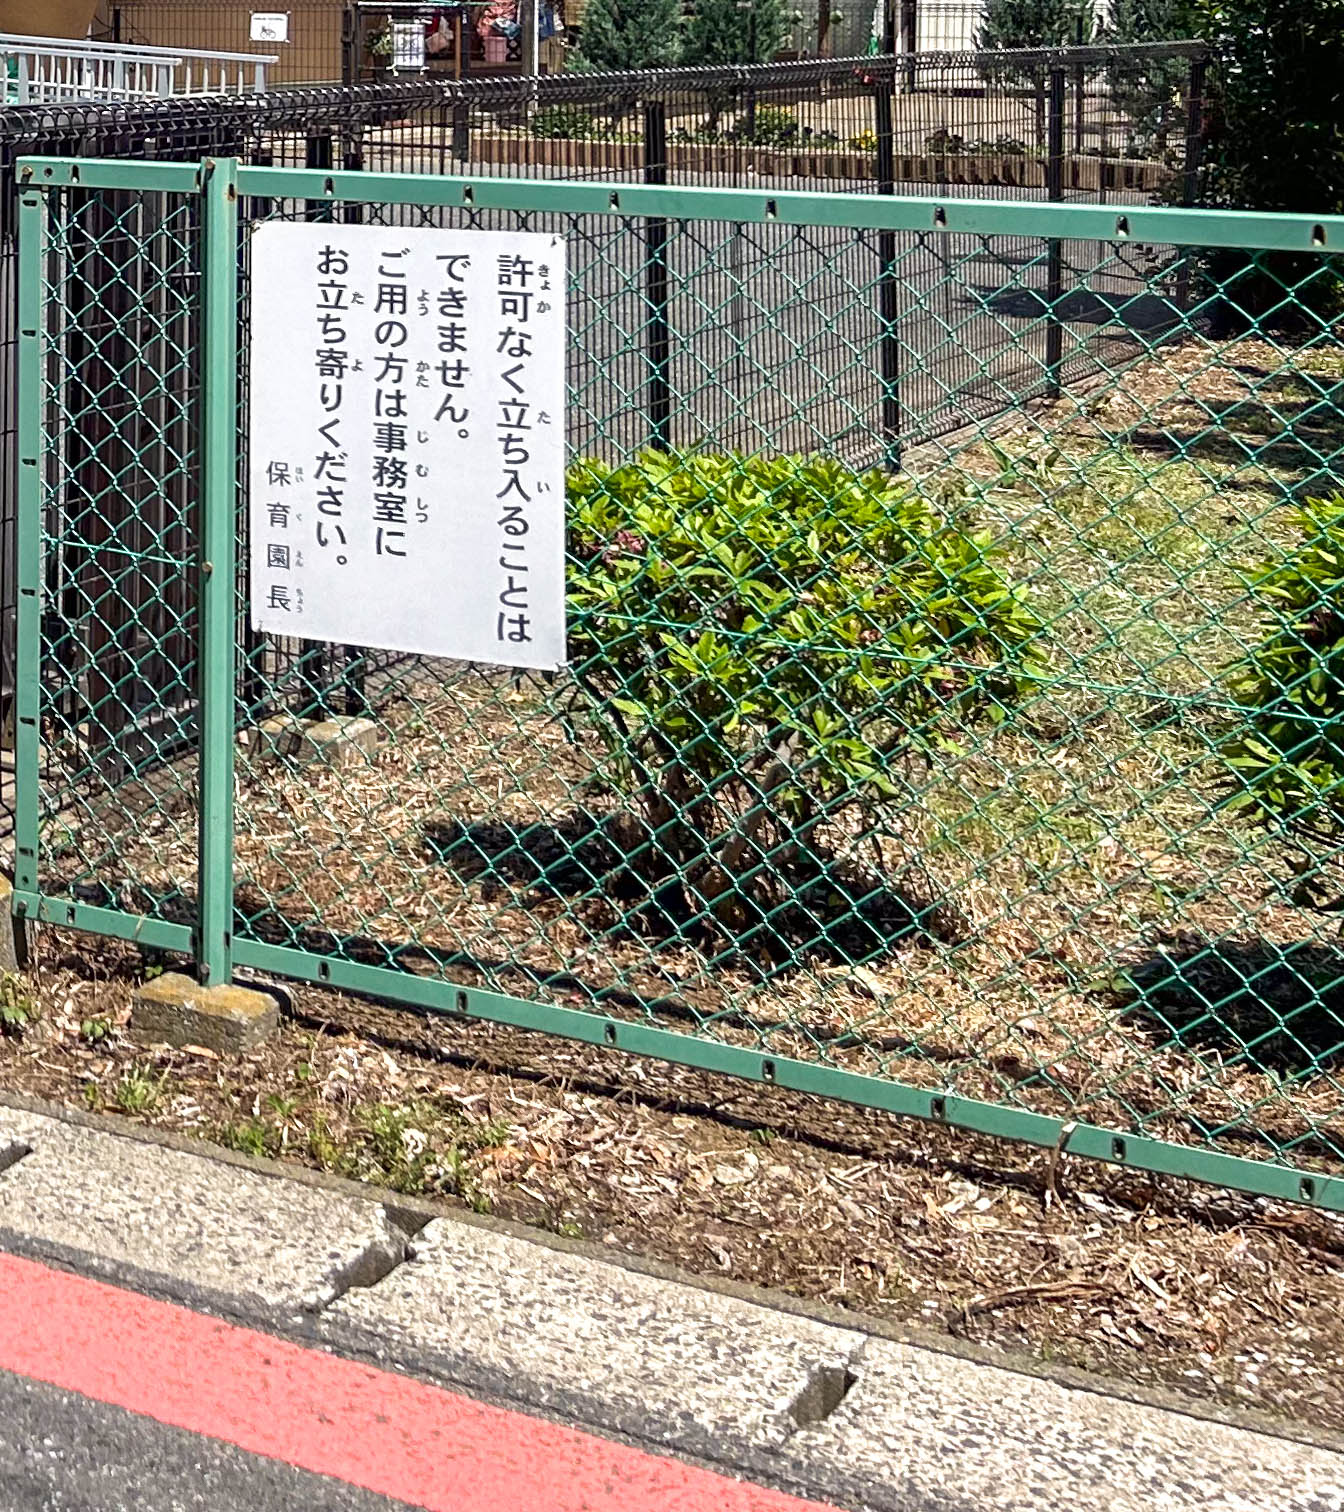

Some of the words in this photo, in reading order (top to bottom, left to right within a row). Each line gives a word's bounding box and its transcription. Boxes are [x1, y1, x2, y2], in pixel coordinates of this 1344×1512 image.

[415, 360, 431, 388] かた
[417, 289, 430, 317] よう
[433, 254, 472, 439] できません。
[314, 245, 349, 566] お立ち寄りください。
[372, 247, 411, 557] ご用の方は事務室に
[496, 254, 534, 643] 許可なく立ち入ることは
[265, 461, 291, 612] 保育園長
